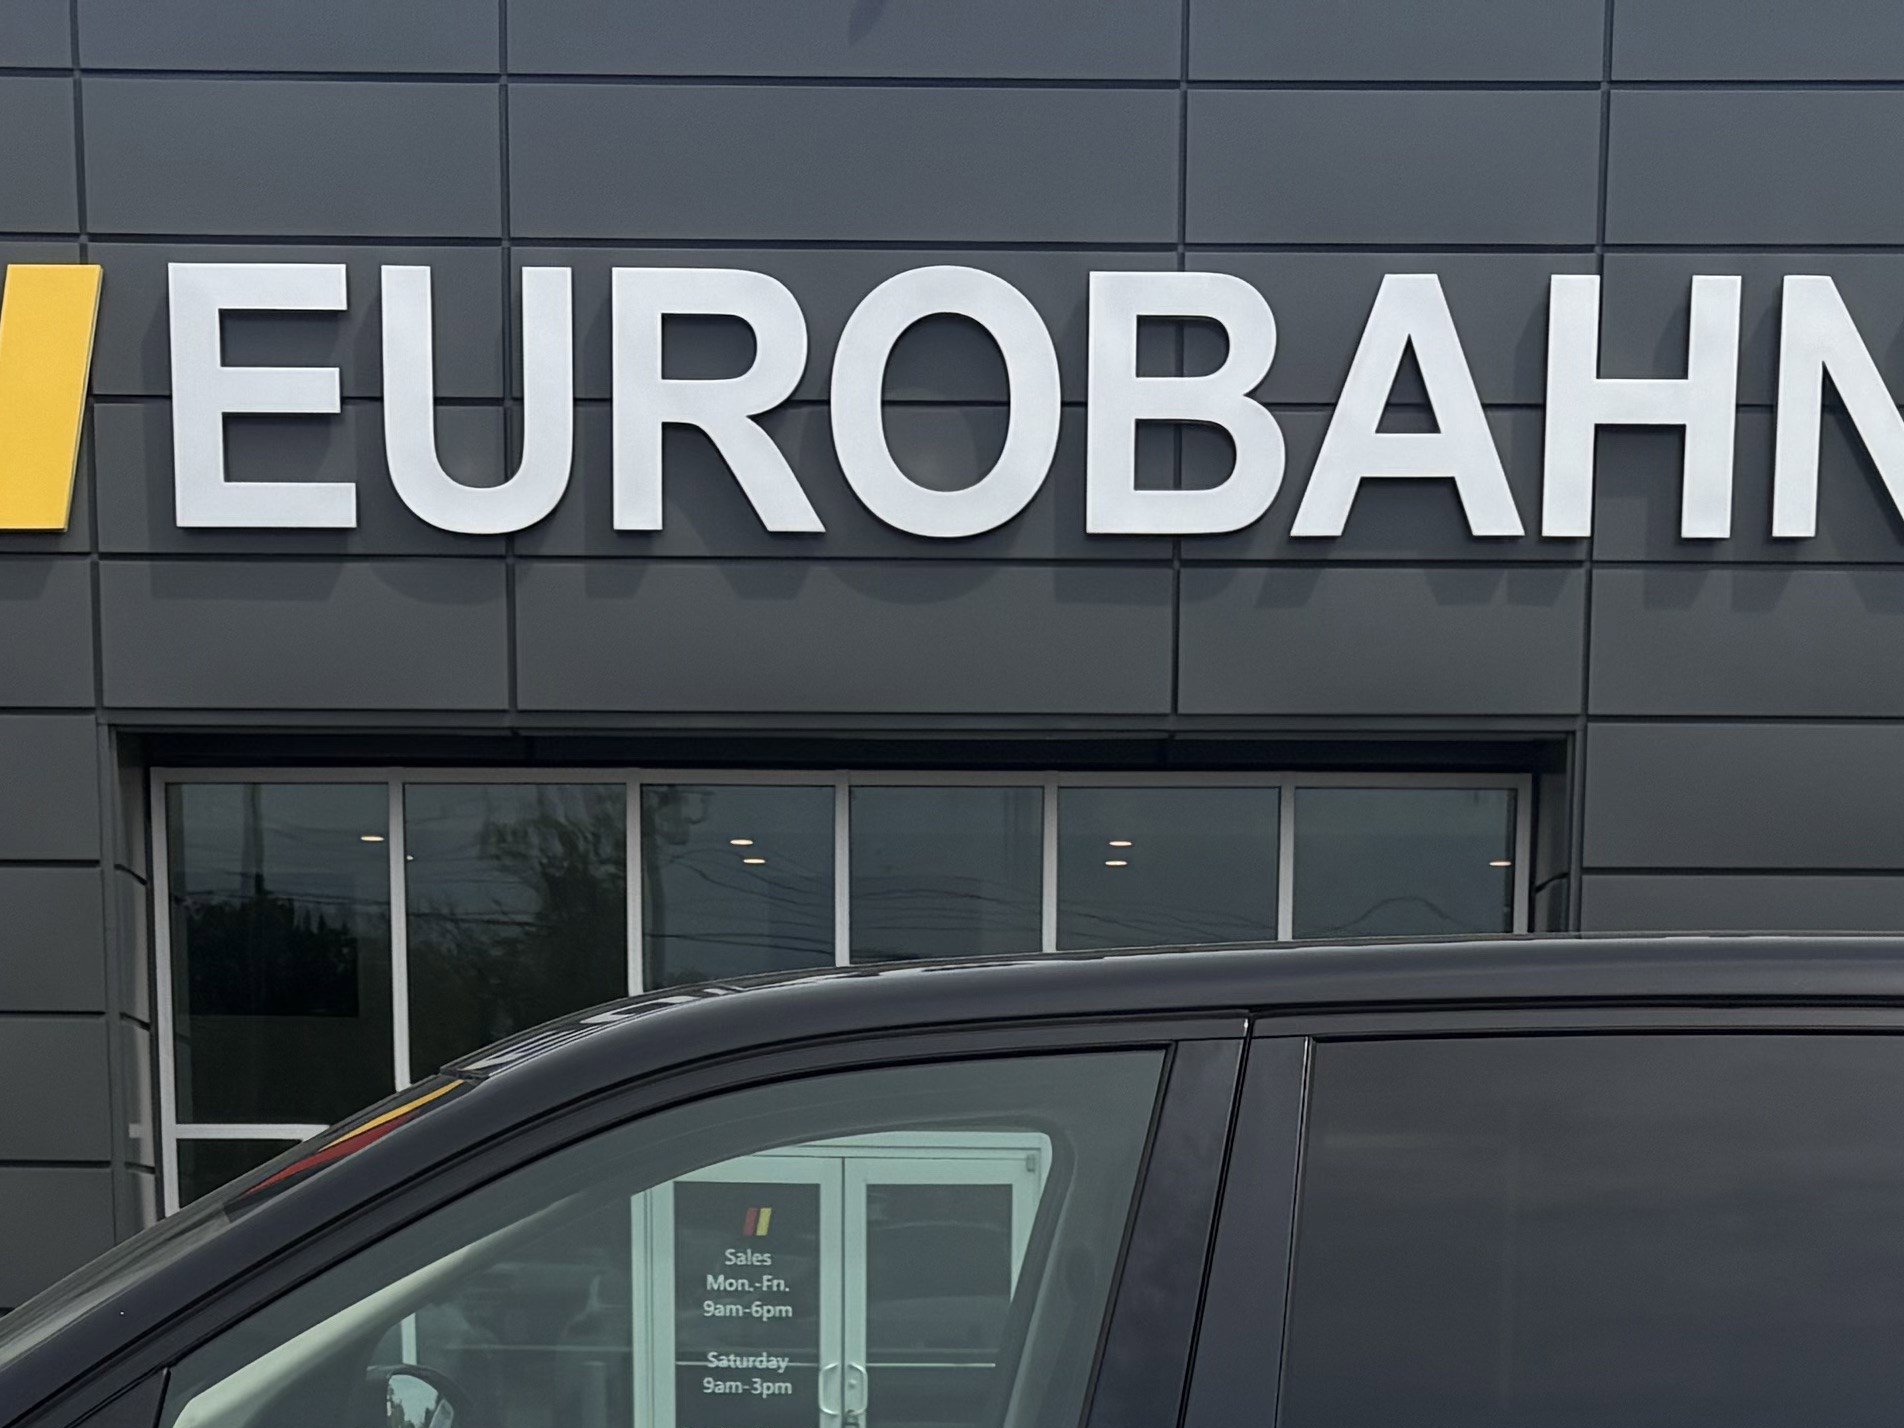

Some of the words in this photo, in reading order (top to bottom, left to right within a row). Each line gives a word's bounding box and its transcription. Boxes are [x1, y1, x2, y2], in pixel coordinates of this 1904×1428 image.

[724, 1248, 772, 1266] Sales
[702, 1300, 793, 1321] 9am-6pm
[707, 1351, 790, 1373] Saturday
[702, 1377, 793, 1399] 9am-3pm
